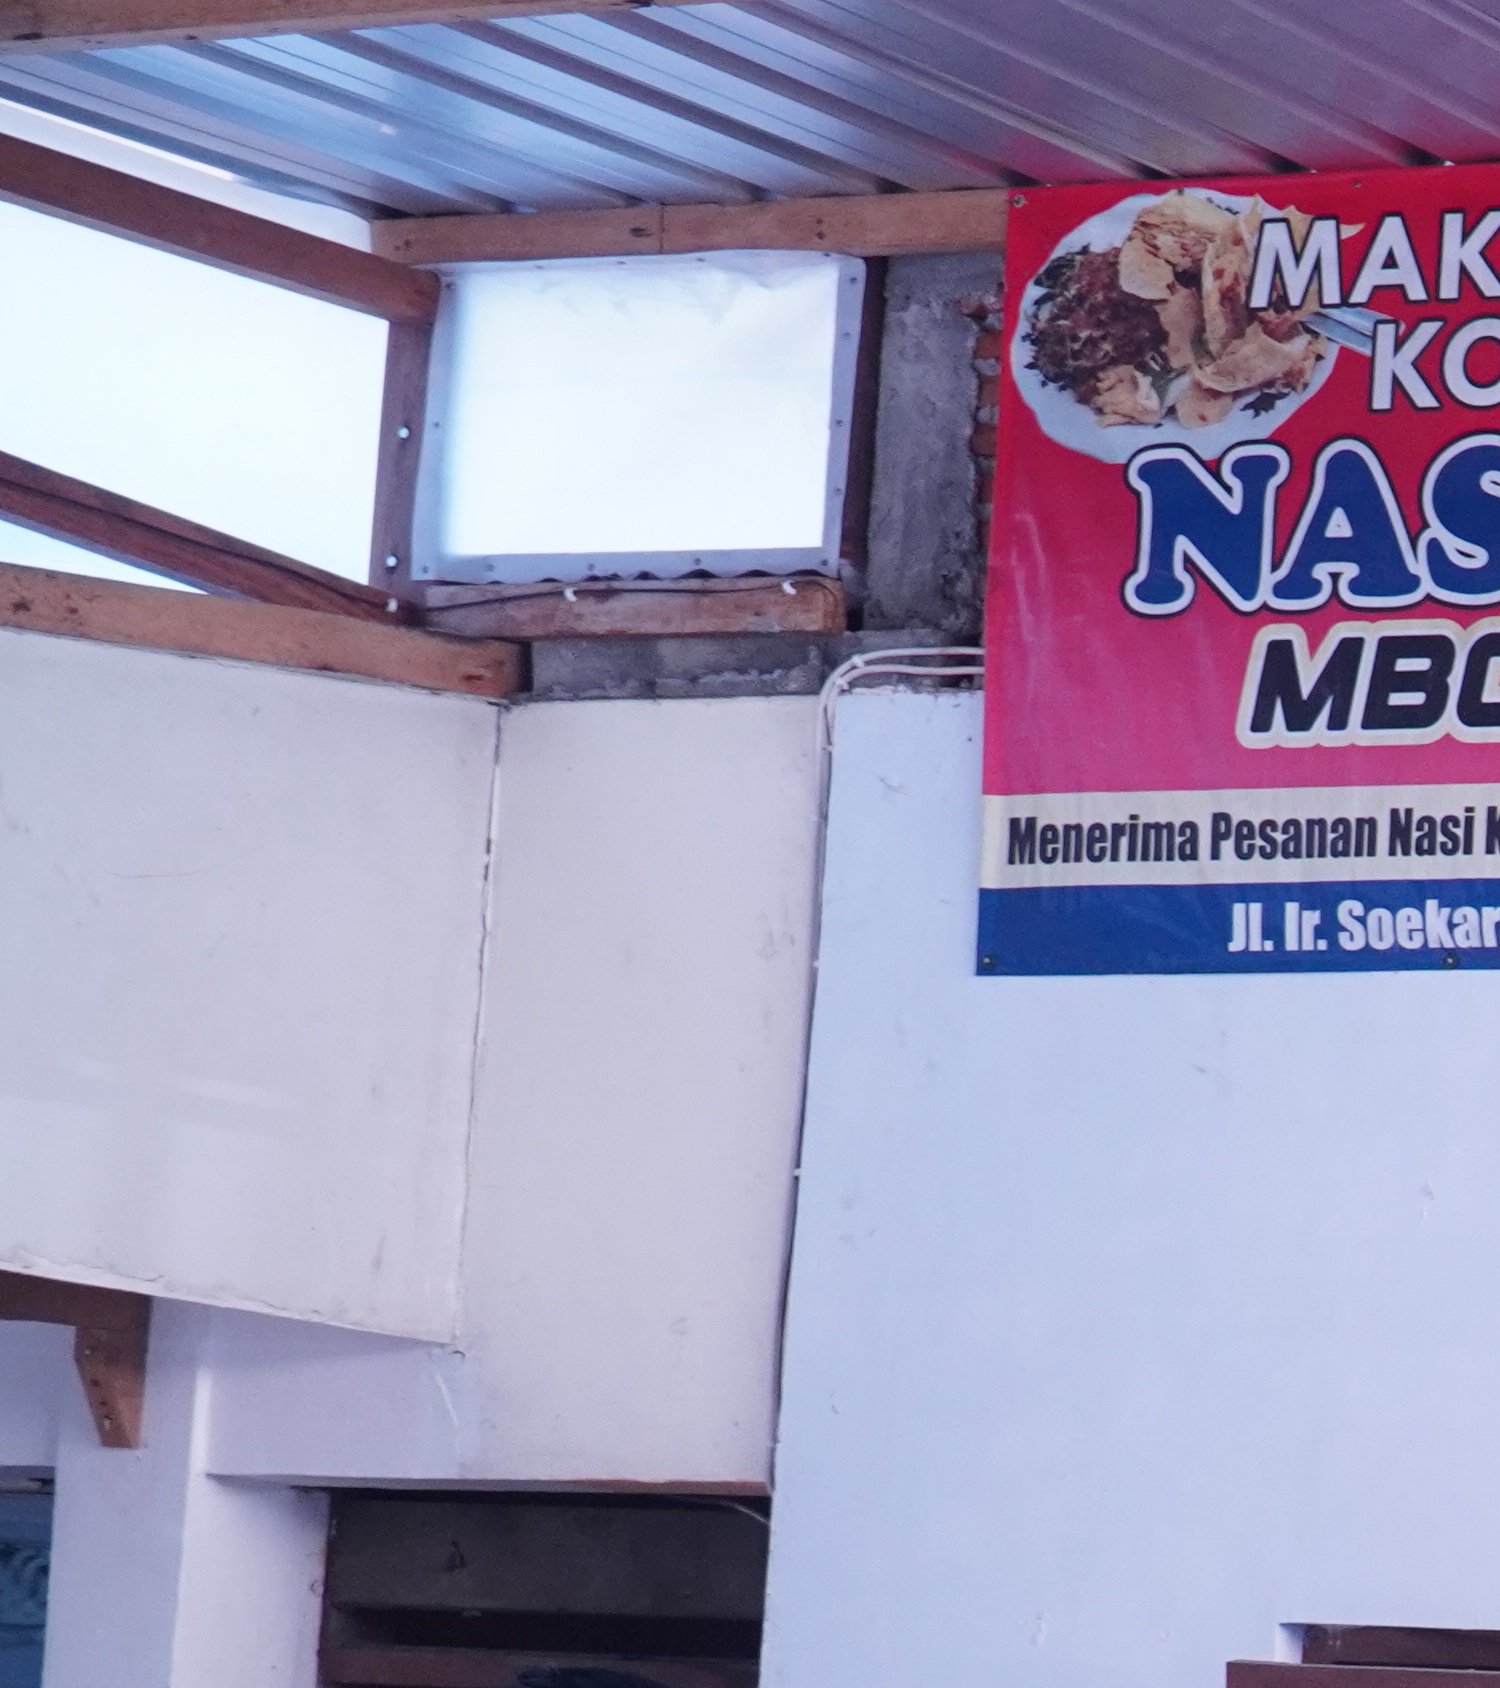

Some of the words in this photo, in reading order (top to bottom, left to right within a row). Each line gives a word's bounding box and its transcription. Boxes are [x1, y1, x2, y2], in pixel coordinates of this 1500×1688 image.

[1007, 814, 1200, 866] Menerima
[1210, 811, 1377, 861] Pesanan
[1388, 806, 1474, 857] Nasi
[1227, 903, 1273, 953] Jl.
[1283, 902, 1327, 952] Ir.
